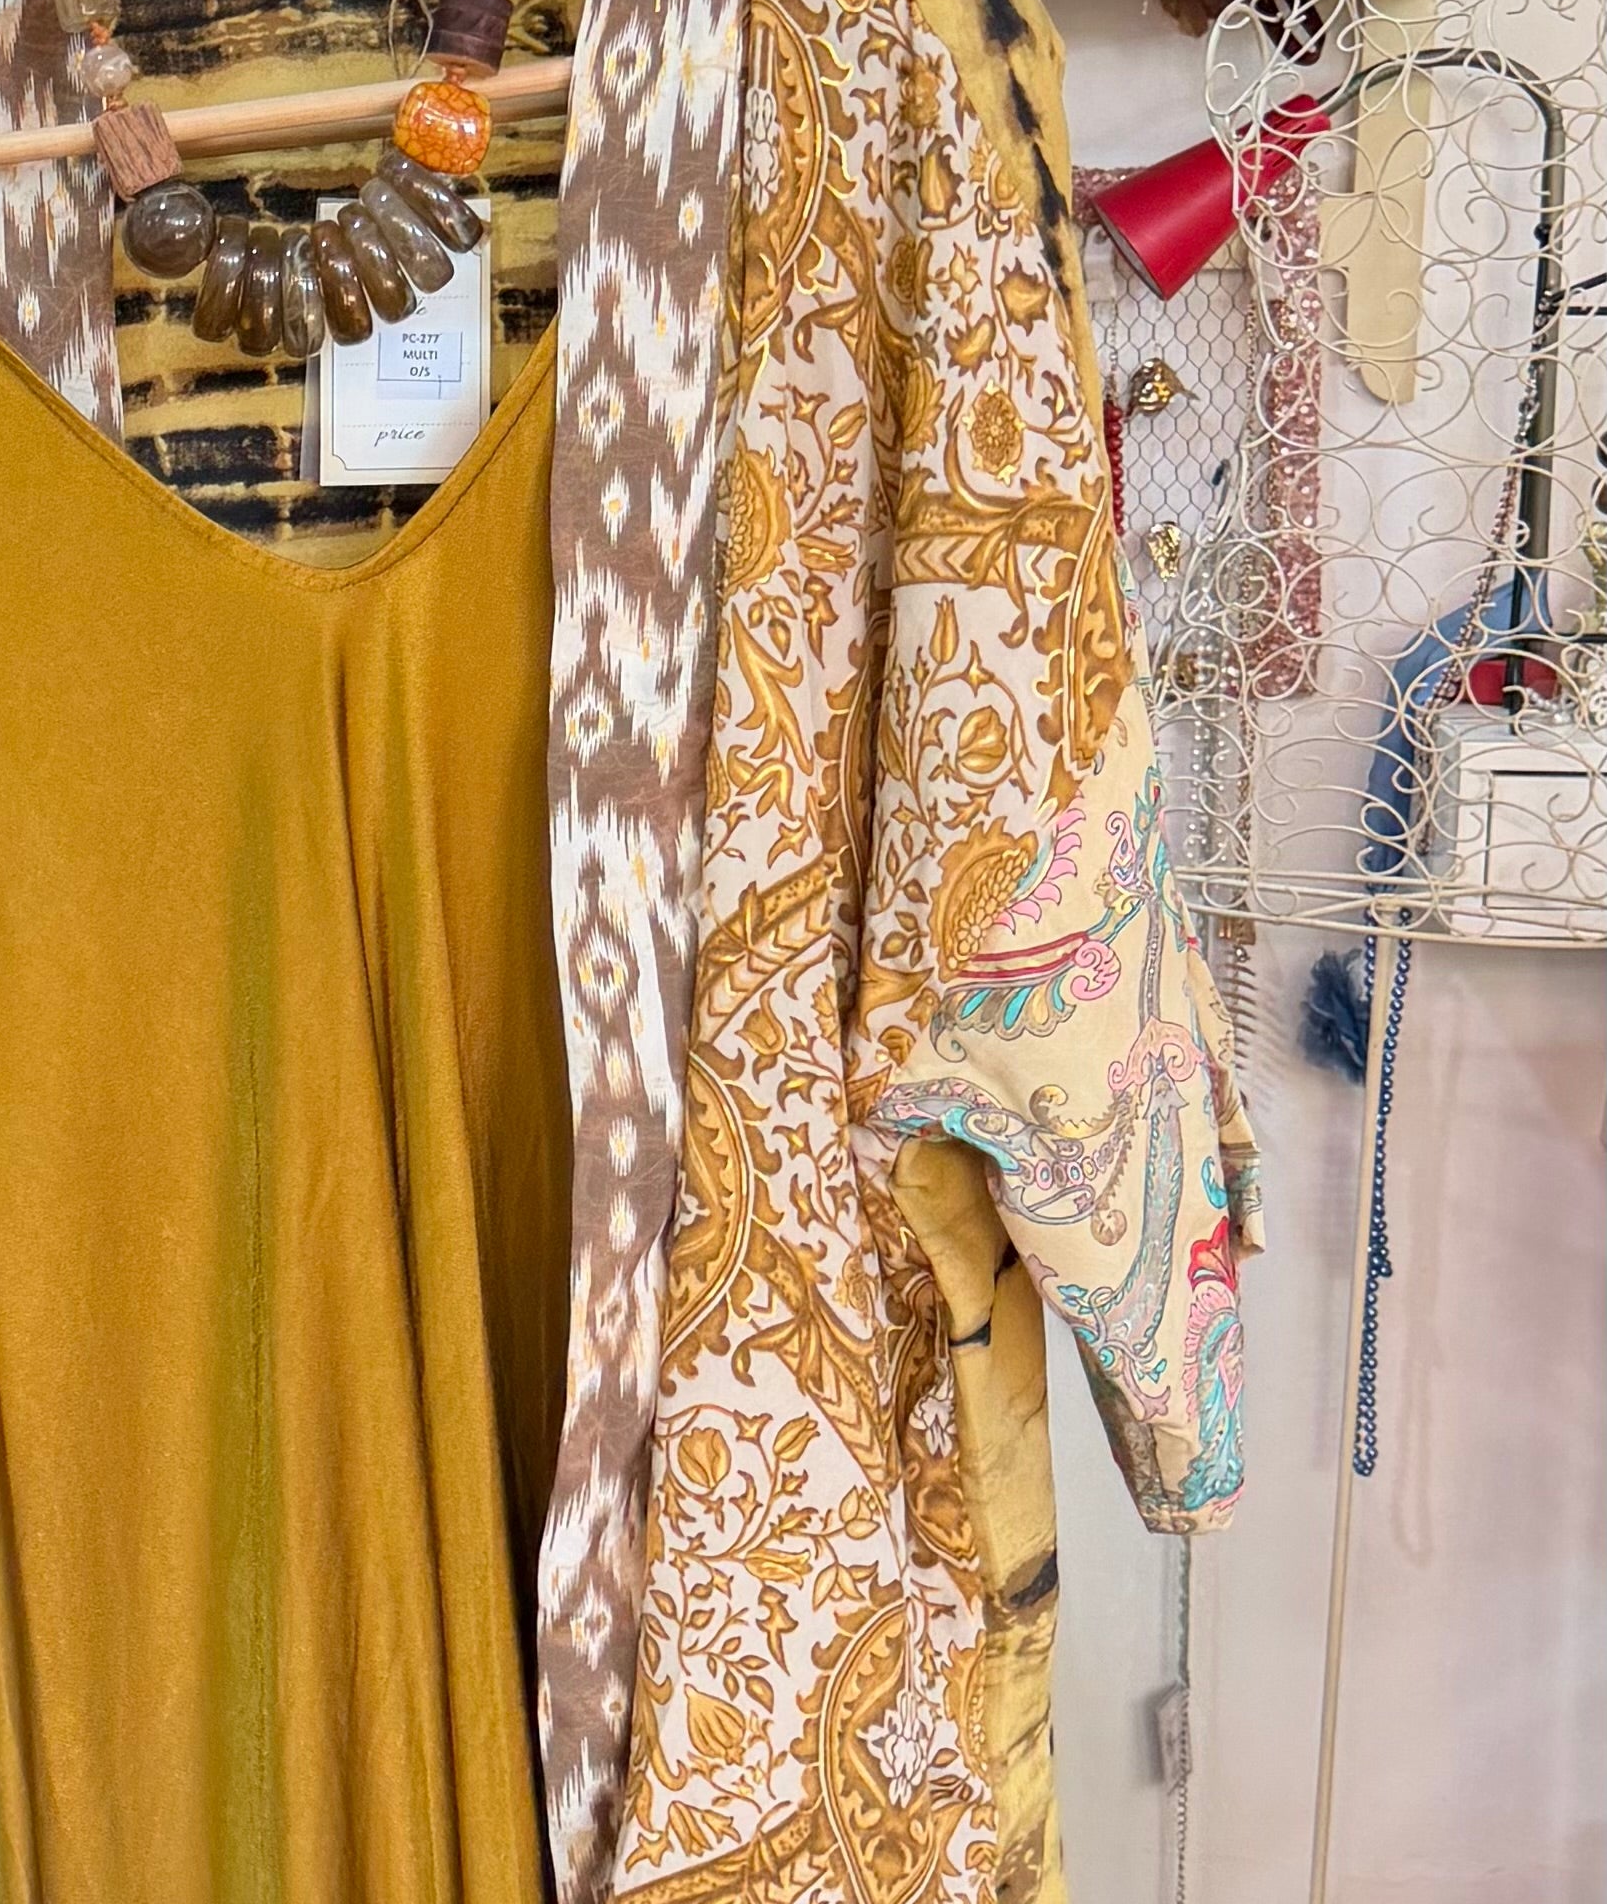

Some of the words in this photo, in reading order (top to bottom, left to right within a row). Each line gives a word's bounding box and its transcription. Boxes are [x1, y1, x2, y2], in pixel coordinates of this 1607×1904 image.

[402, 333, 441, 344] PC-277
[402, 350, 438, 360] MULTI
[409, 366, 431, 377] O/S
[374, 426, 426, 447] price
